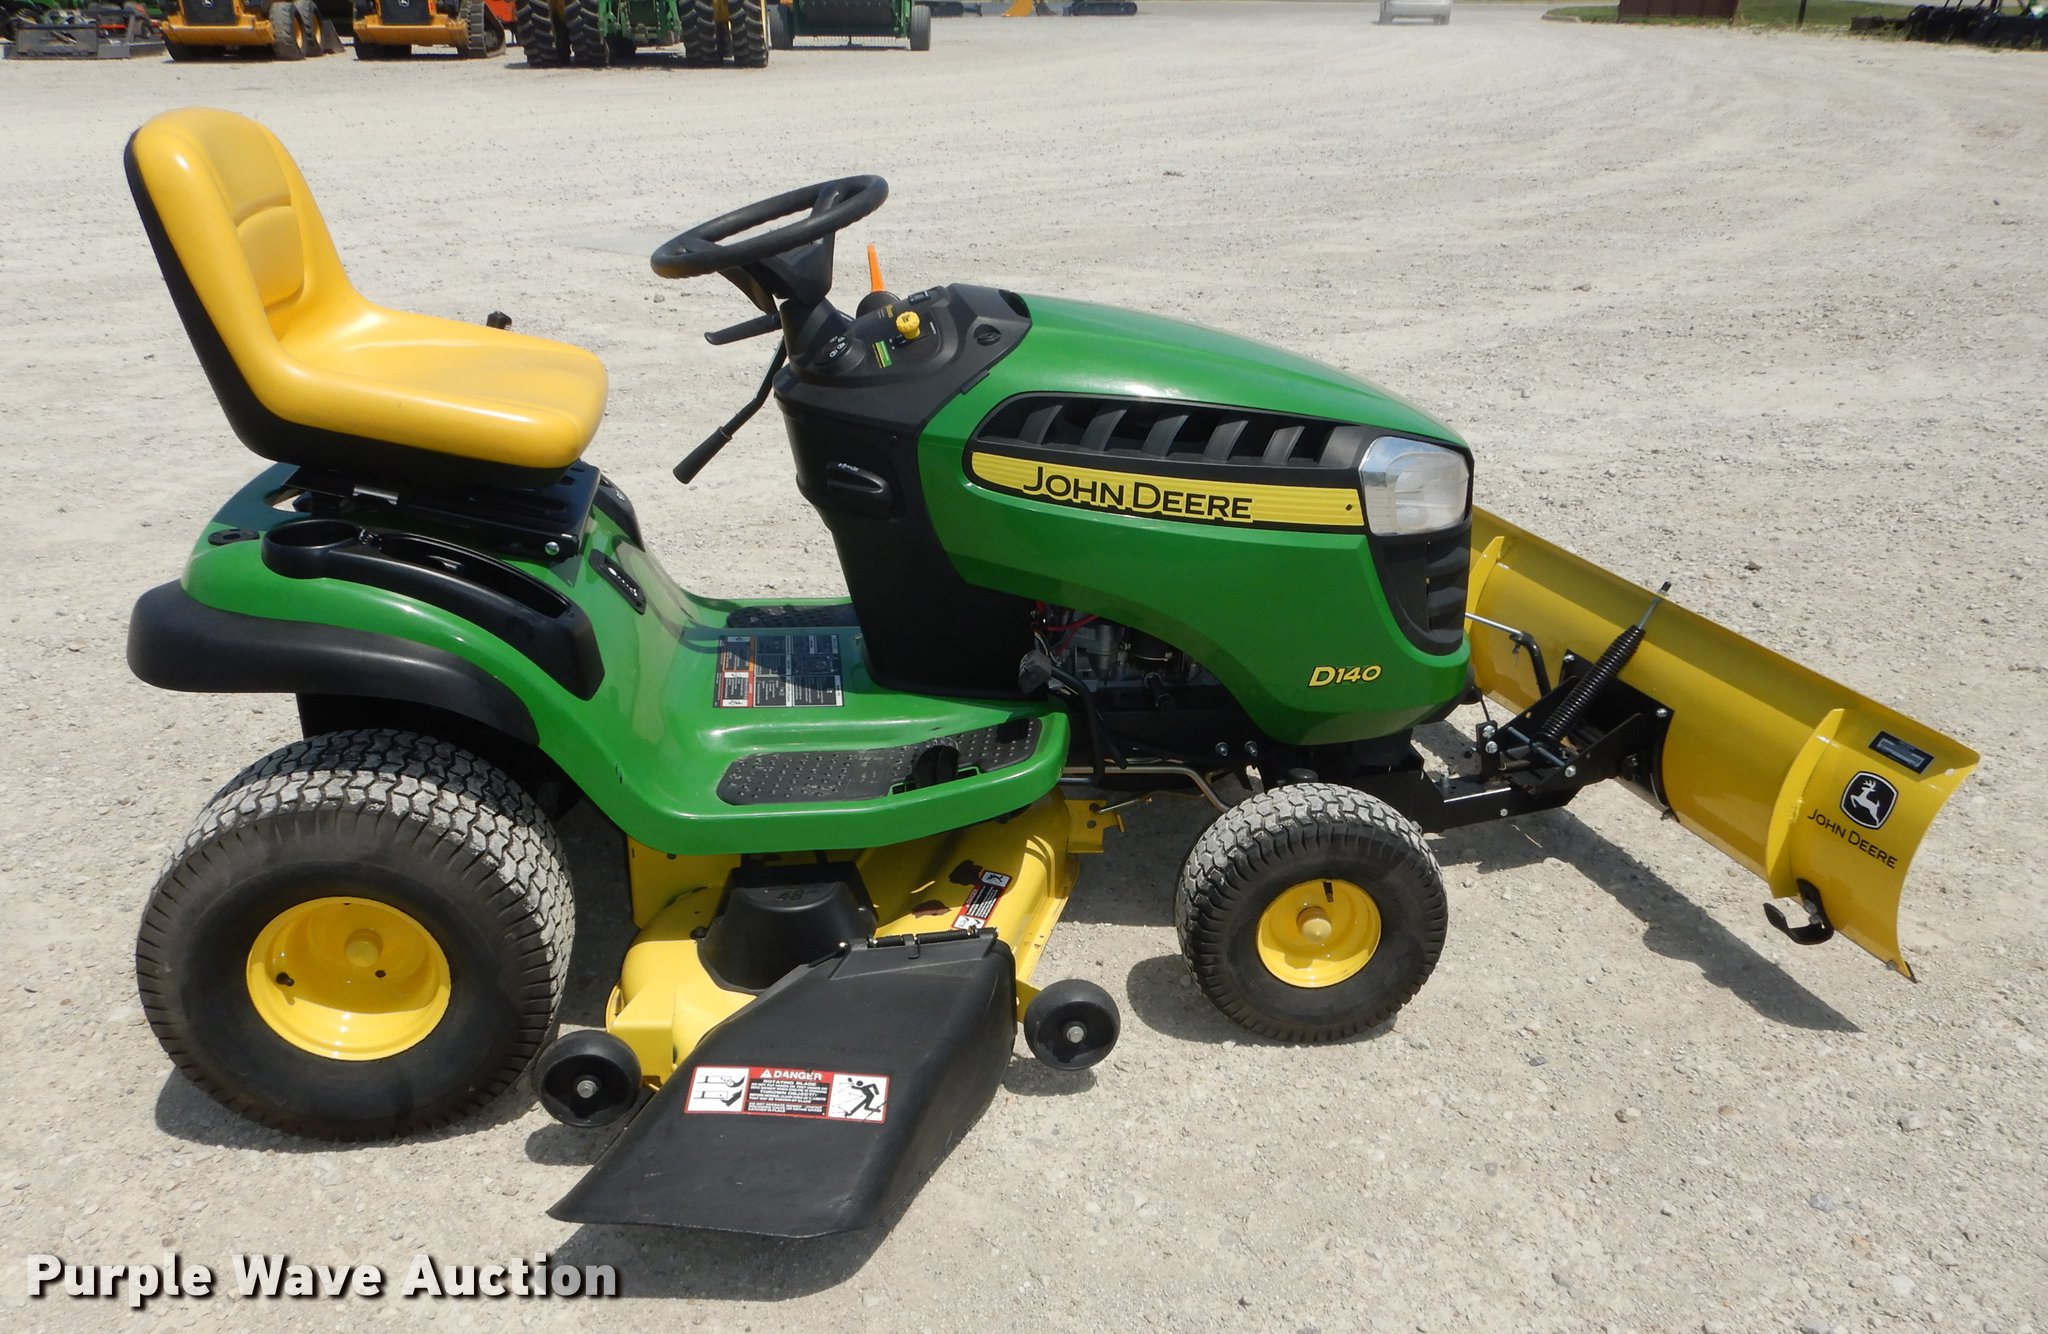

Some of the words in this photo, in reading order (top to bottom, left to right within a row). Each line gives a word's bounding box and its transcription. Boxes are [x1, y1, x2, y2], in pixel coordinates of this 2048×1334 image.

[1023, 466, 1124, 506] JOHN
[1132, 482, 1253, 519] DEERE
[1308, 665, 1382, 687] D140
[1808, 809, 1846, 838] JOHN
[1848, 831, 1898, 869] DEERE
[773, 1070, 822, 1081] DANGER
